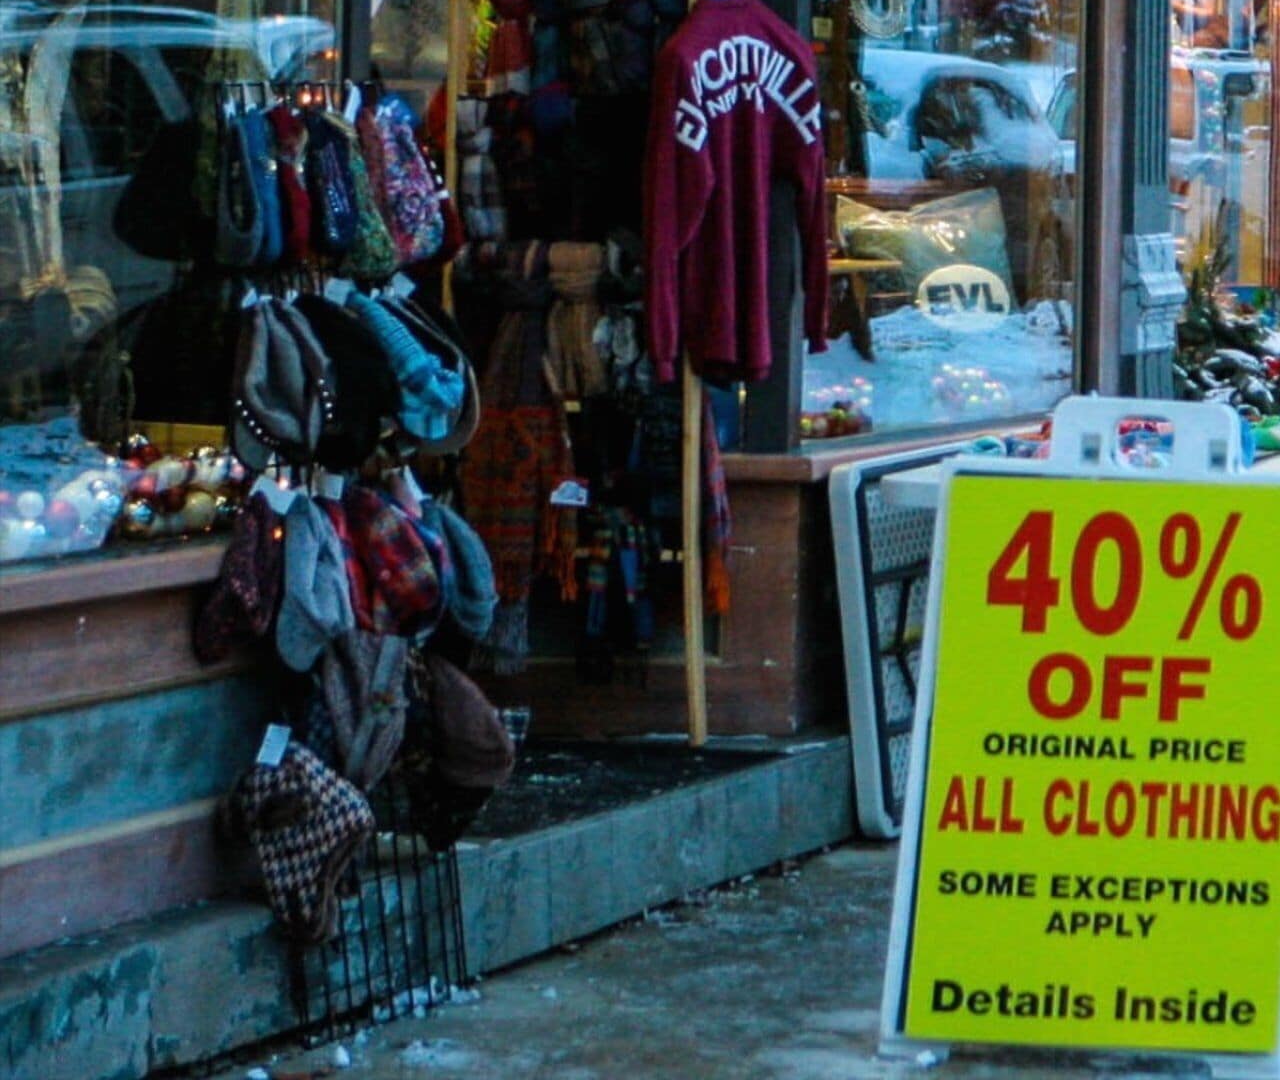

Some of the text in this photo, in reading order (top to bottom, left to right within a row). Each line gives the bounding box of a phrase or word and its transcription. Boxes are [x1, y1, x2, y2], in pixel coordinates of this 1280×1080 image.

[925, 282, 1006, 316] EVL
[986, 511, 1262, 641] 40%
[1028, 653, 1211, 722] OFF
[983, 733, 1244, 763] ORIGINAL PRICE
[938, 777, 1280, 842] ALL CLOTHING
[938, 871, 1270, 905] SOME EXCEPTIONS
[1045, 911, 1155, 937] APPLY
[931, 980, 1256, 1025] Details Inside
